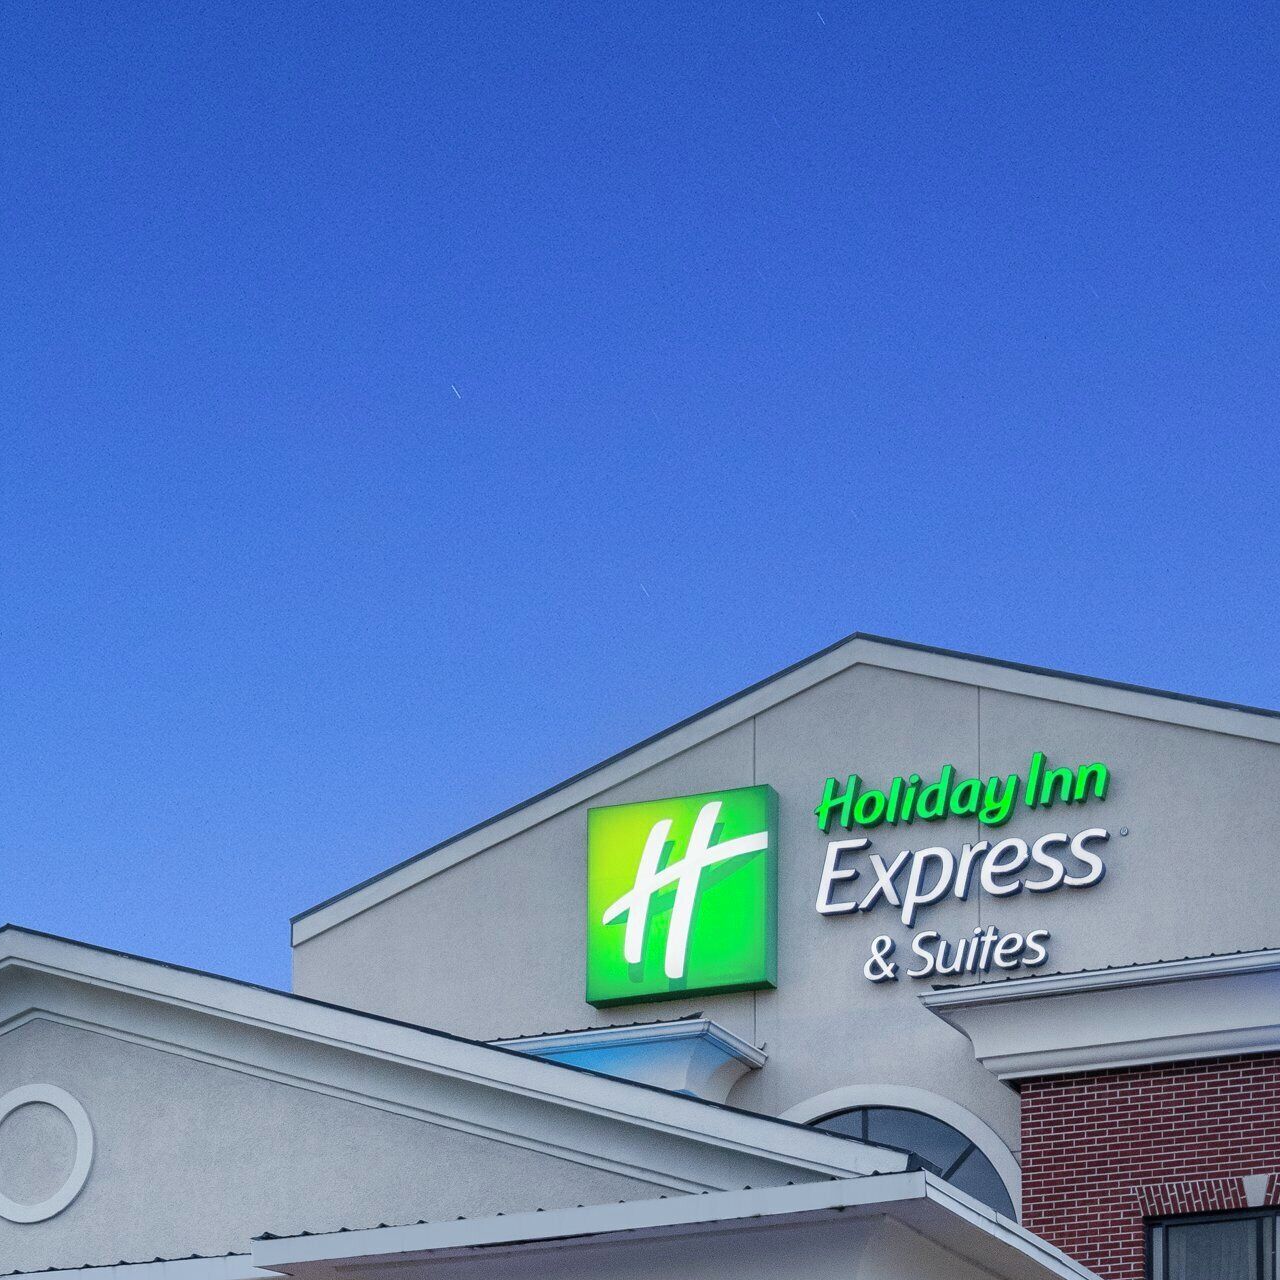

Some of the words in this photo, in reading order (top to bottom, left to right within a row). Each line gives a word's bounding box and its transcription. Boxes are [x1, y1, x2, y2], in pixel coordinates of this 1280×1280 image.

[814, 764, 1019, 833] Holiday
[1025, 751, 1110, 809] Inn
[603, 801, 768, 979] H
[815, 828, 1110, 926] Express
[863, 935, 898, 982] &
[906, 925, 1051, 978] Suites
